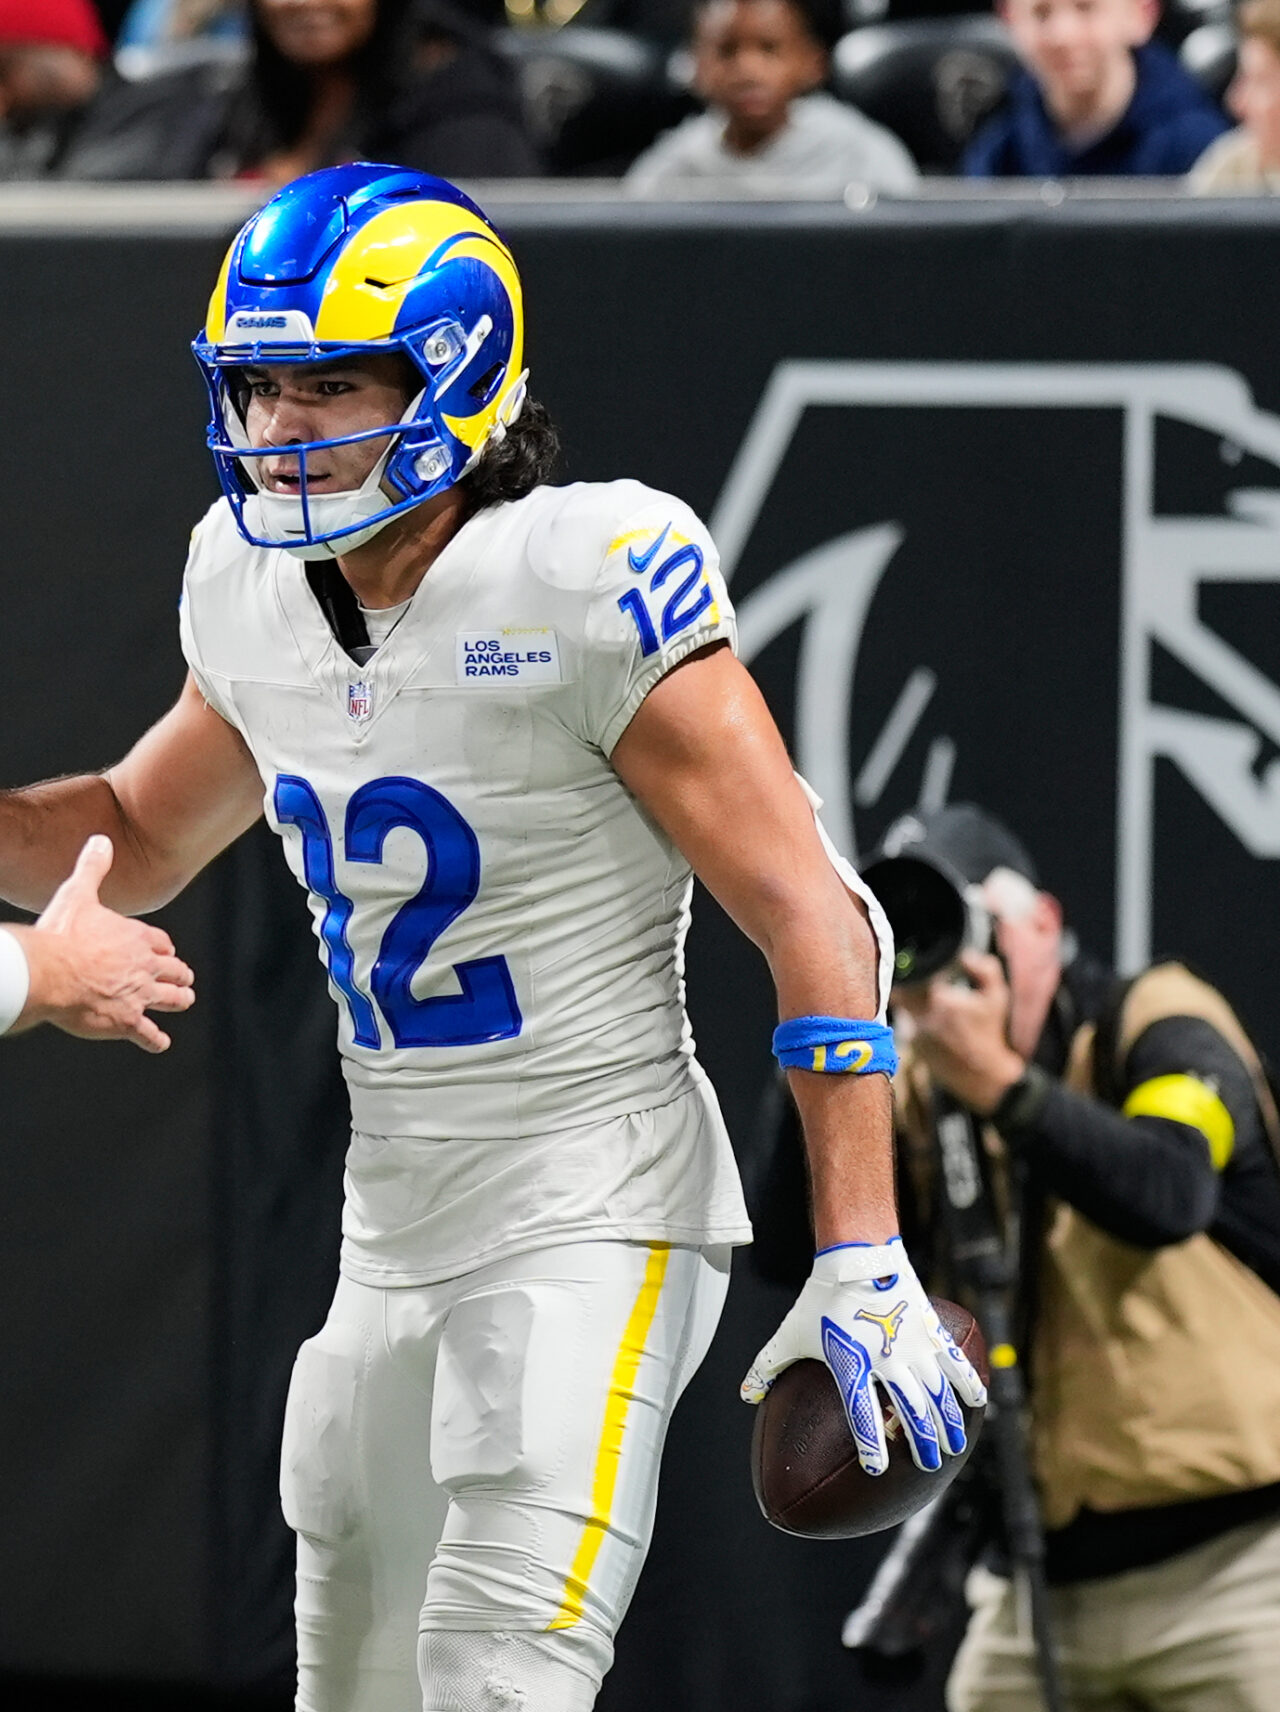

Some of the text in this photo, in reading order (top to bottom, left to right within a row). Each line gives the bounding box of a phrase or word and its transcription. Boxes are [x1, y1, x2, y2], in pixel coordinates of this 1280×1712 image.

[617, 543, 714, 658] 12
[464, 640, 500, 652] LOS
[465, 651, 552, 664] ANGELES
[465, 664, 519, 677] RAMS
[351, 699, 369, 716] NFL
[274, 773, 523, 1050] 12
